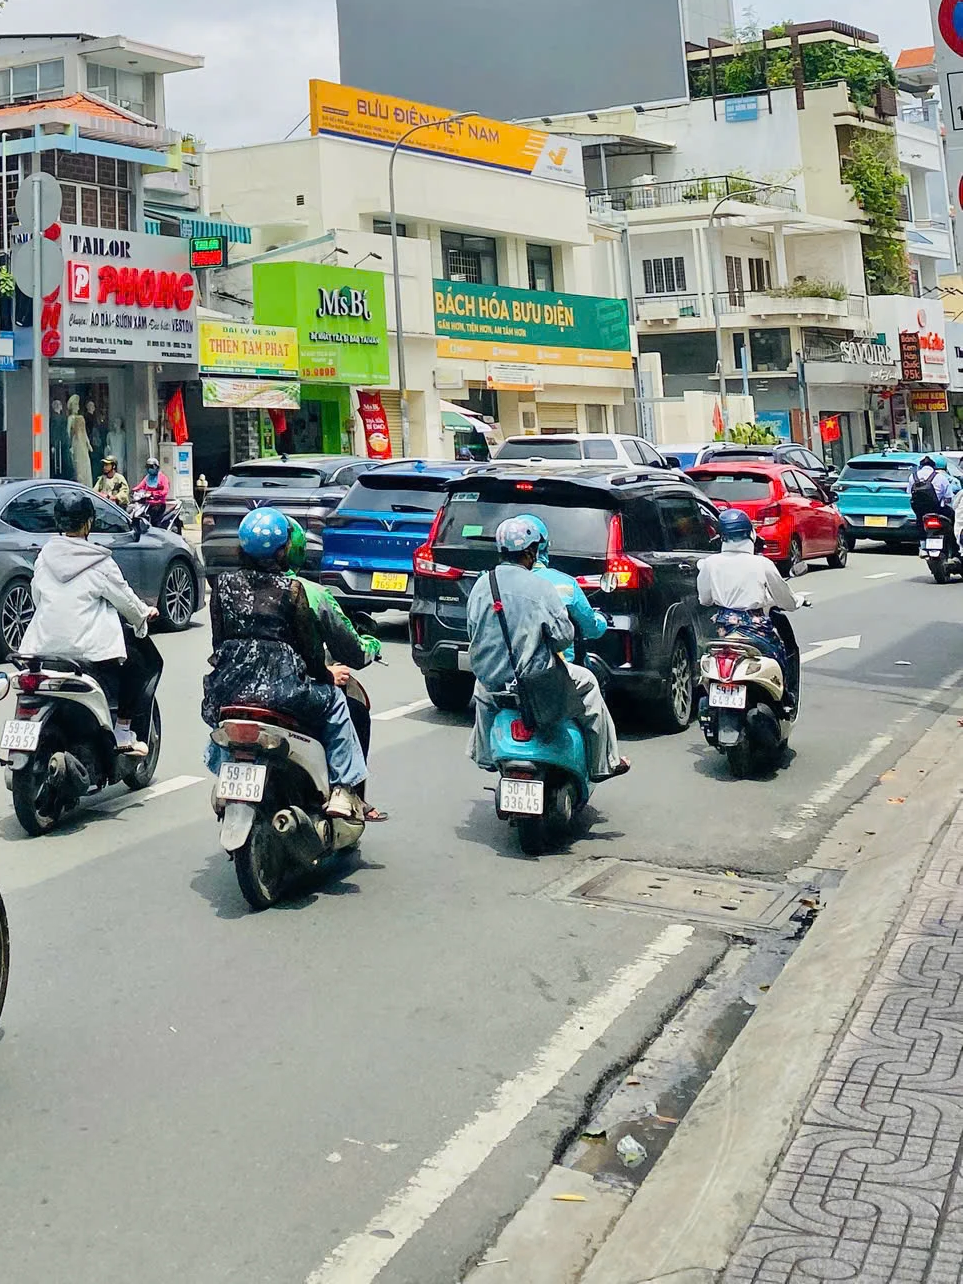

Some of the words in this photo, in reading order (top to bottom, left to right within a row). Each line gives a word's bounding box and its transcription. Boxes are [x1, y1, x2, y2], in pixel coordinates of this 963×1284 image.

[357, 98, 388, 120] BƯU
[468, 124, 499, 144] NAM
[69, 234, 131, 259] TAILOR
[97, 265, 195, 312] PHONG
[434, 287, 475, 317] BÁCH
[478, 292, 510, 320] HÓA
[513, 300, 541, 325] BƯU
[544, 300, 574, 333] ĐIỆN
[904, 369, 921, 380] 95k
[8, 721, 36, 735] 59-P2
[227, 765, 257, 782] 59-B1
[504, 795, 540, 812] 336.45
